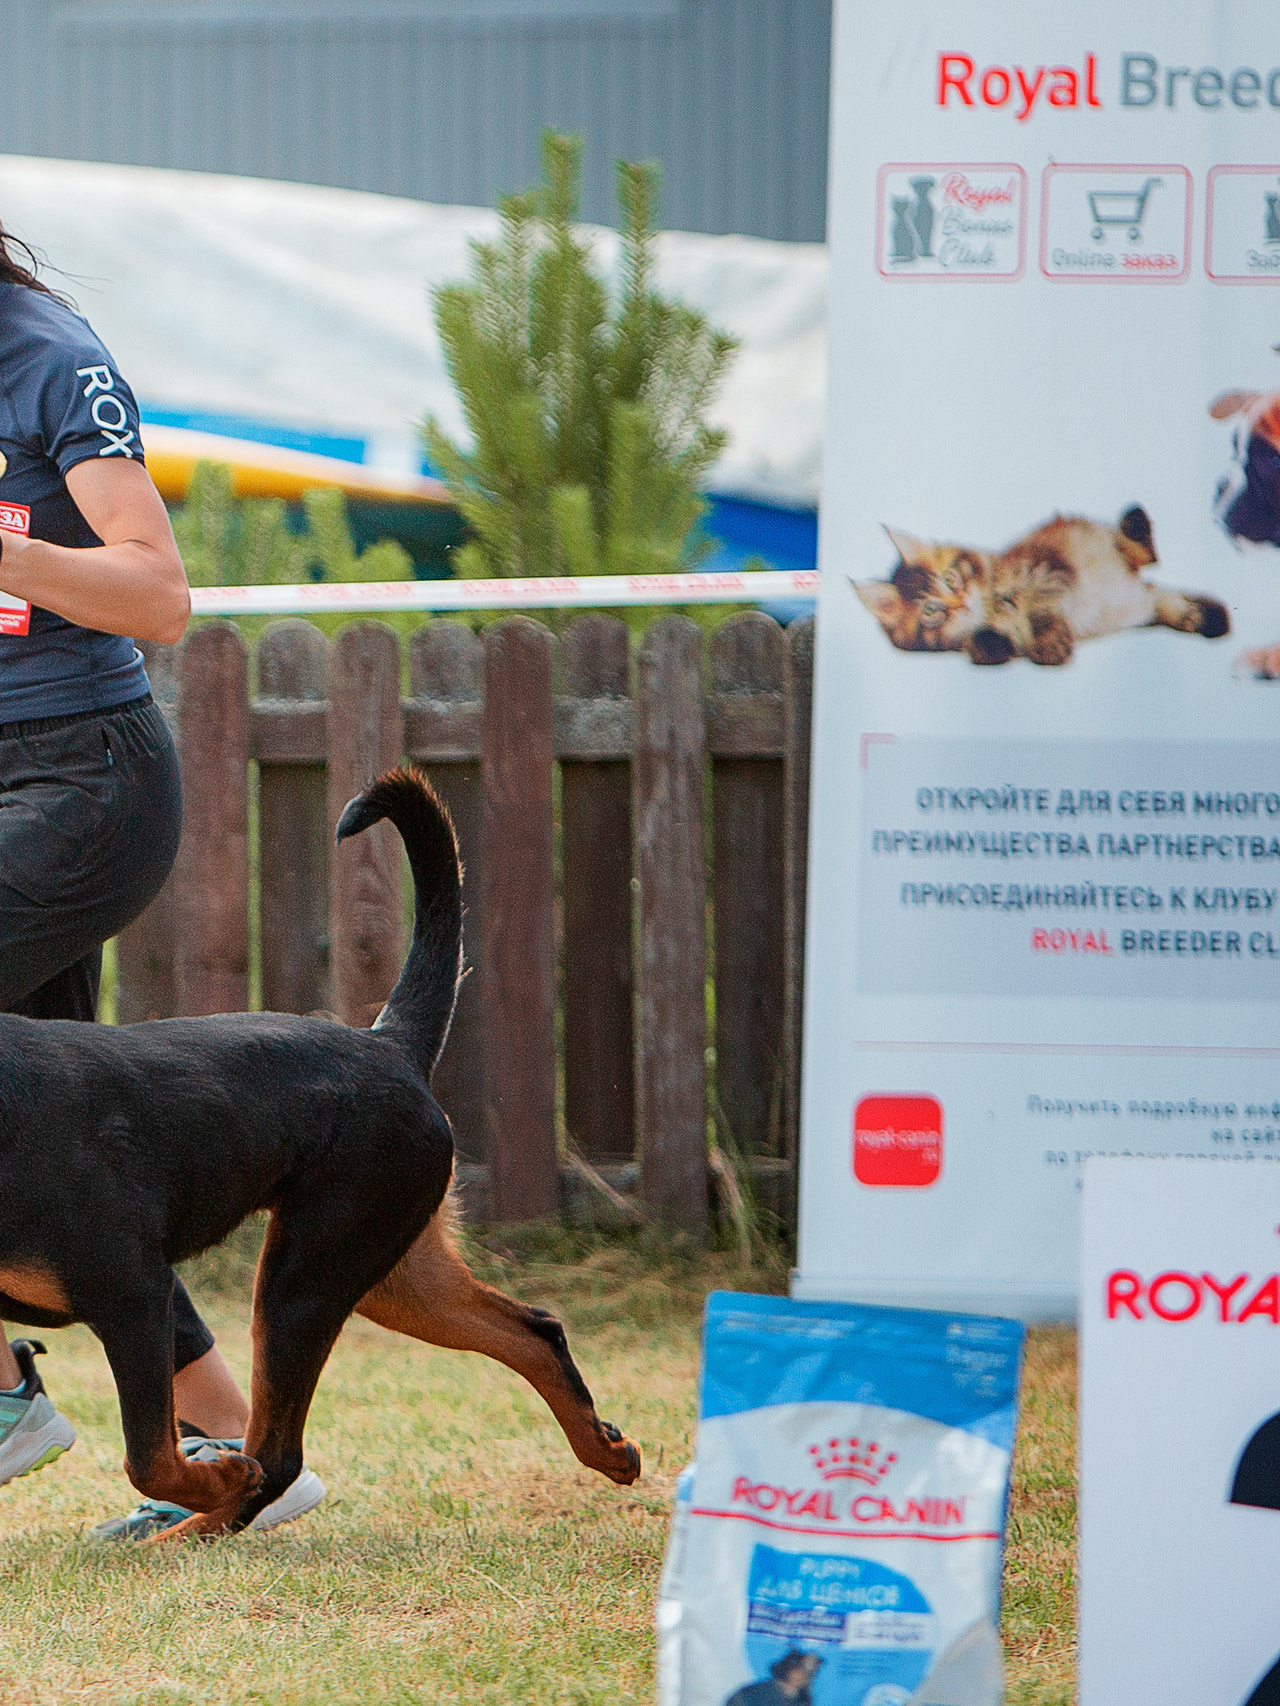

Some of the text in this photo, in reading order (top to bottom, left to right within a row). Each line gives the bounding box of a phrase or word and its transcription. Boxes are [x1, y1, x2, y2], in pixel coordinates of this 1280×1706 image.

[937, 51, 1101, 121] Royal
[76, 364, 135, 459] ROX
[917, 783, 1280, 816] ОТКРОЙТЕ ДЛЯ СЕБЯ МНОГО
[872, 829, 1280, 859] ПРЕИМУЩЕСТВА ПАРТНЕРСТВА
[901, 880, 1279, 913] ПРИСОЕДИНЯЙТЕСЬ К КЛУБУ
[1032, 927, 1114, 956] ROYAL
[1122, 929, 1241, 957] BREEDER
[1106, 1270, 1280, 1324] ROYA
[732, 1475, 840, 1521] ROYAL
